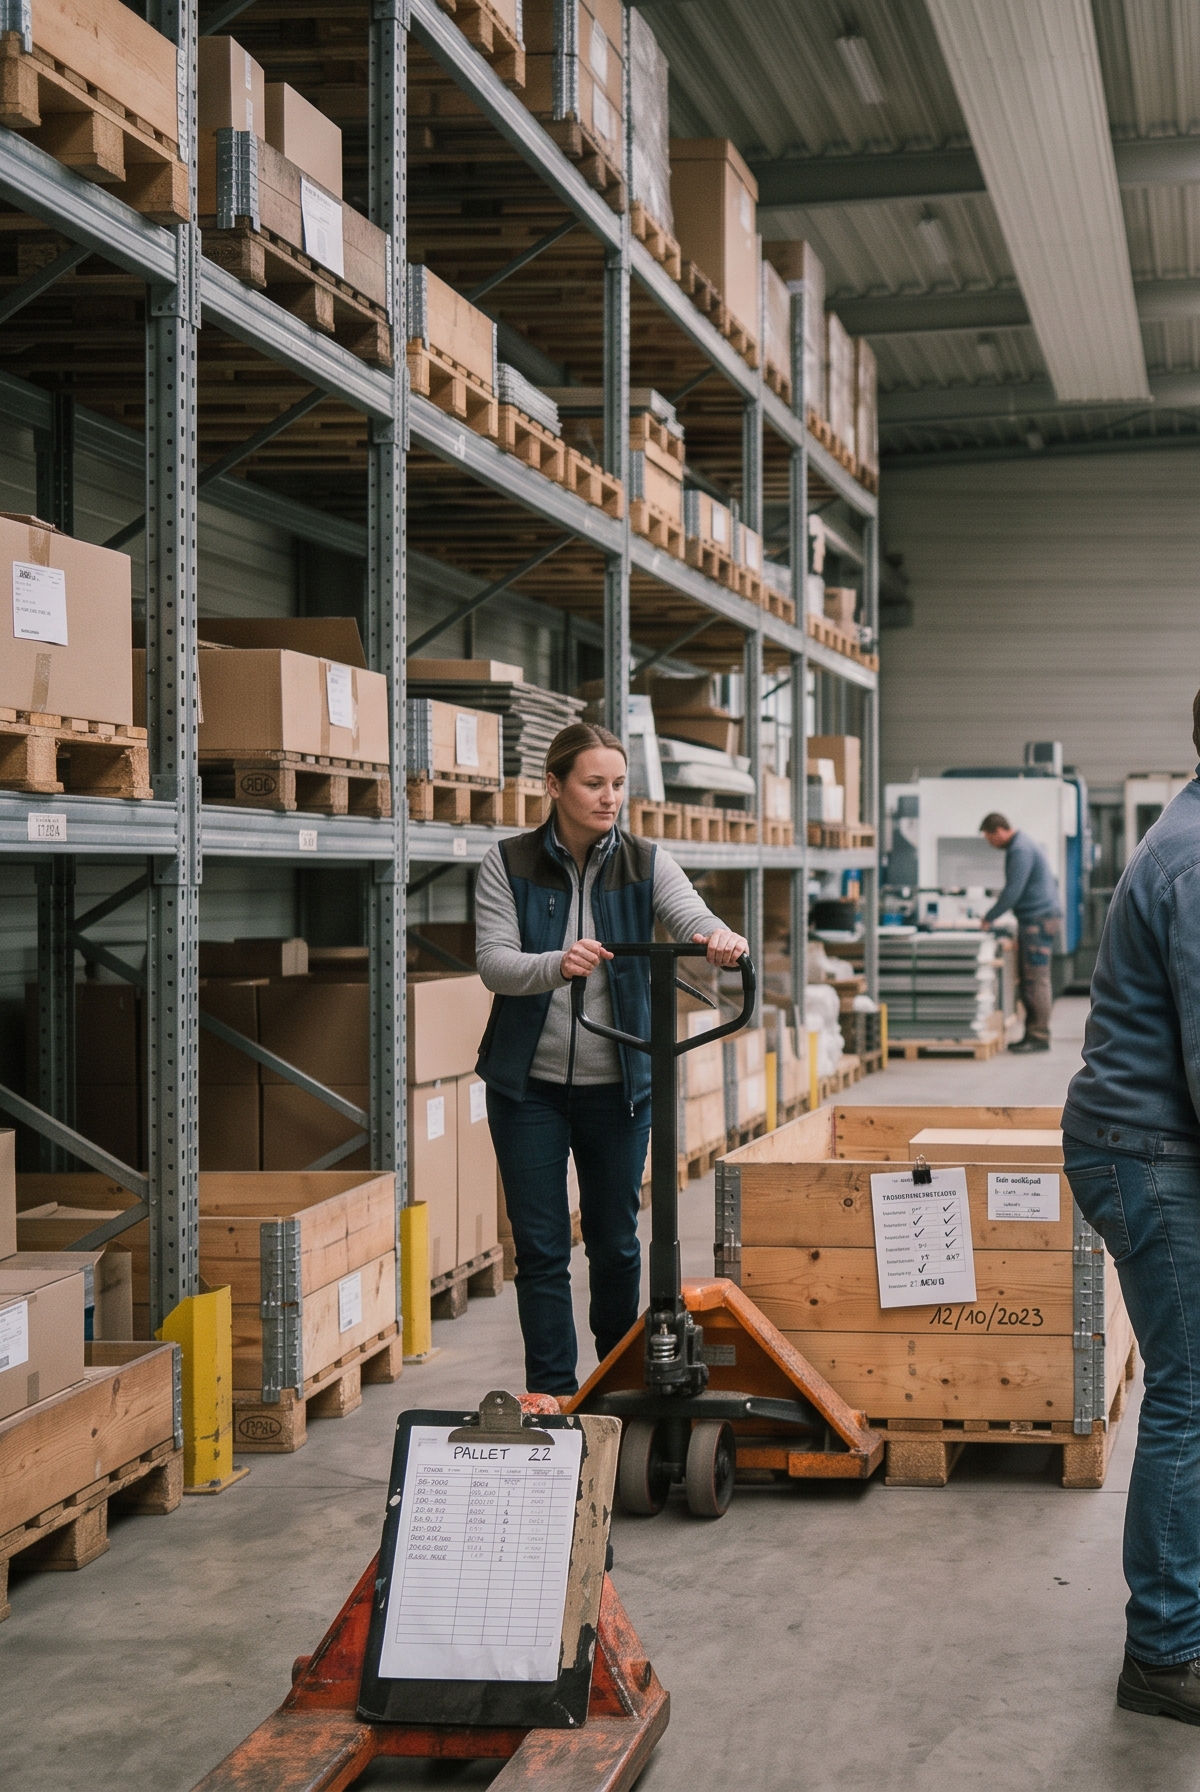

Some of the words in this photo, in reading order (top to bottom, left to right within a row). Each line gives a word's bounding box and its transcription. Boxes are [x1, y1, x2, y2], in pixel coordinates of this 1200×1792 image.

[929, 1302, 1044, 1332] 12/10/2023
[453, 1446, 511, 1460] PALLET
[528, 1447, 552, 1461] 22
